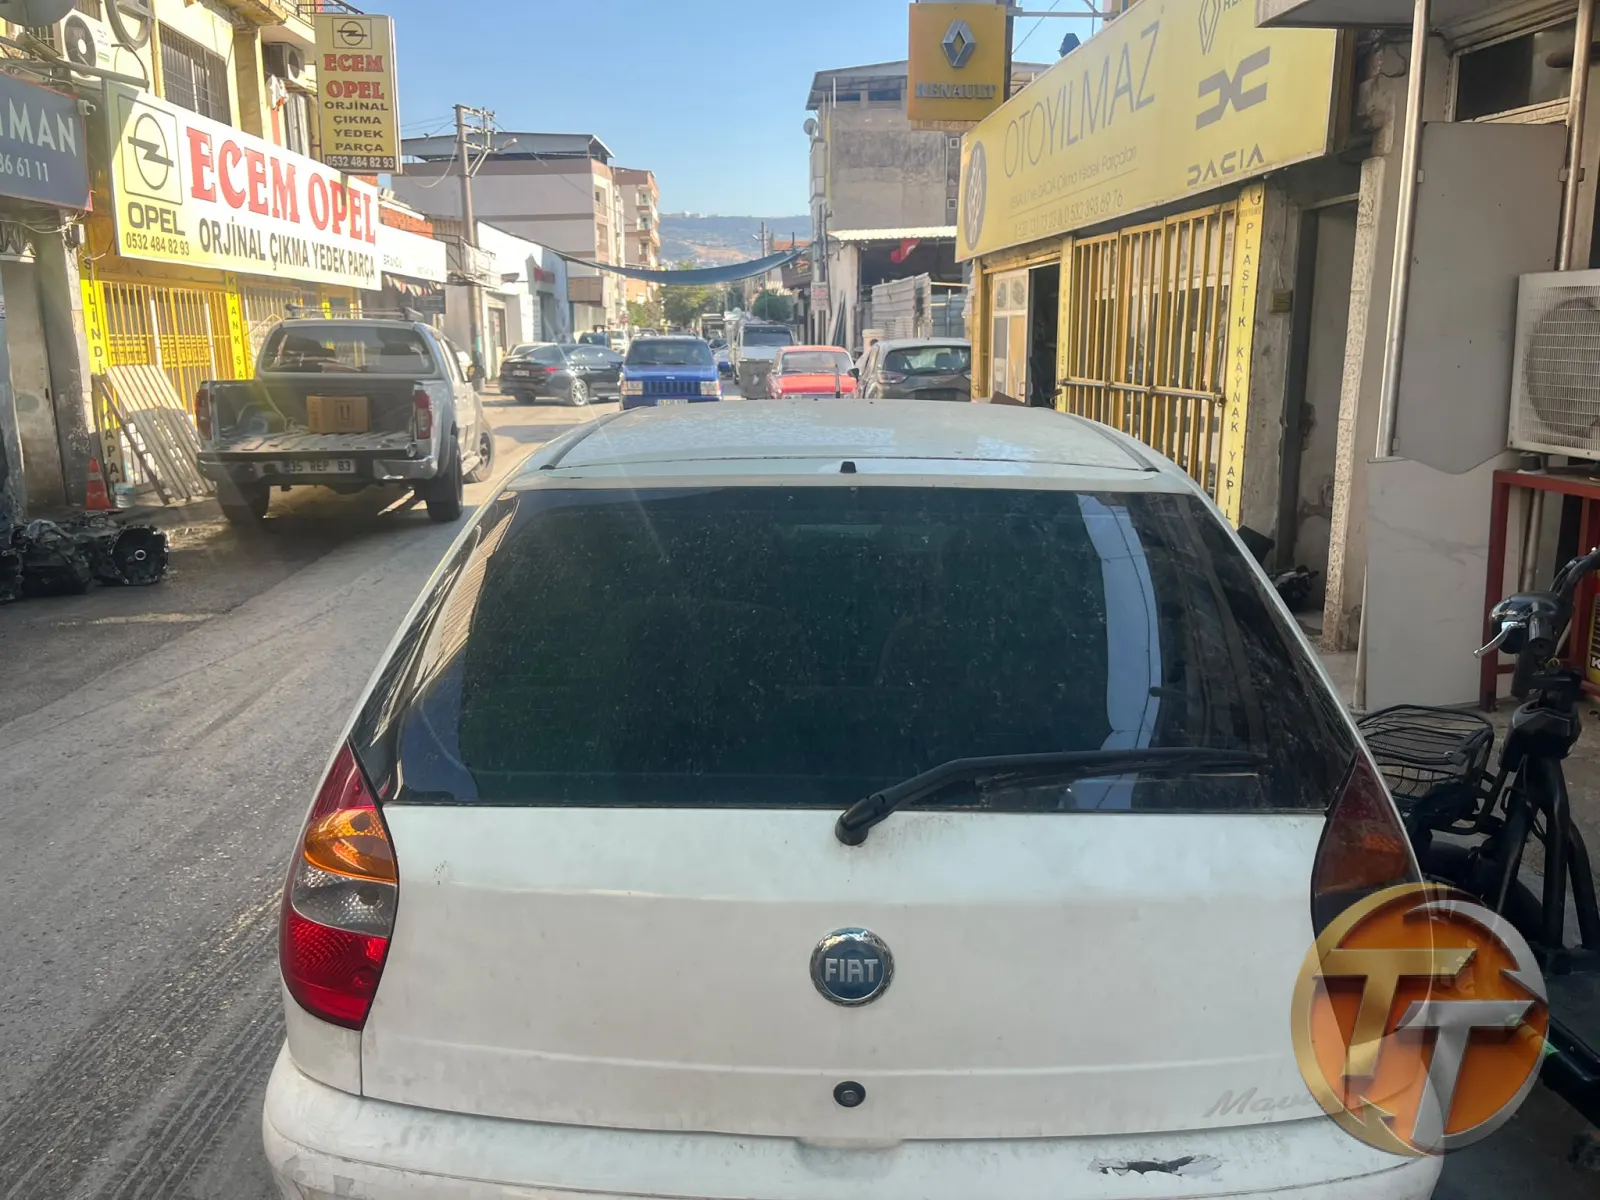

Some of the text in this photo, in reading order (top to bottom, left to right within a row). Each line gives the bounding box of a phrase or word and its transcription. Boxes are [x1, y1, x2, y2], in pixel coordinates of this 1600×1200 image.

[323, 53, 384, 72] ECEM
[326, 80, 384, 99] OPEL
[915, 83, 996, 99] RENAULT
[1004, 20, 1160, 179] OTOYILMAZ
[324, 100, 389, 111] ORJİNAL
[333, 115, 382, 125] ÇIKMA
[333, 129, 383, 138] YEDEK
[335, 142, 384, 153] PARÇA
[16, 156, 31, 178] 61
[35, 160, 49, 182] 11
[327, 156, 394, 168] 0532 484 82 93
[1187, 143, 1265, 187] DACIA
[186, 126, 376, 246] ECEM OPEL
[127, 201, 186, 236] OPEL
[126, 232, 190, 256] 0532 484 82 93
[199, 215, 376, 285] ORJİNAL ÇIKMA YEDEK PARÇA
[1238, 222, 1255, 328] PLASTİK
[83, 257, 105, 375] SİLİNDİ
[227, 275, 245, 379] KRANK ŞA
[1231, 346, 1245, 433] KAYNAK
[1225, 450, 1237, 520] YAPIL
[825, 958, 878, 983] FIAT
